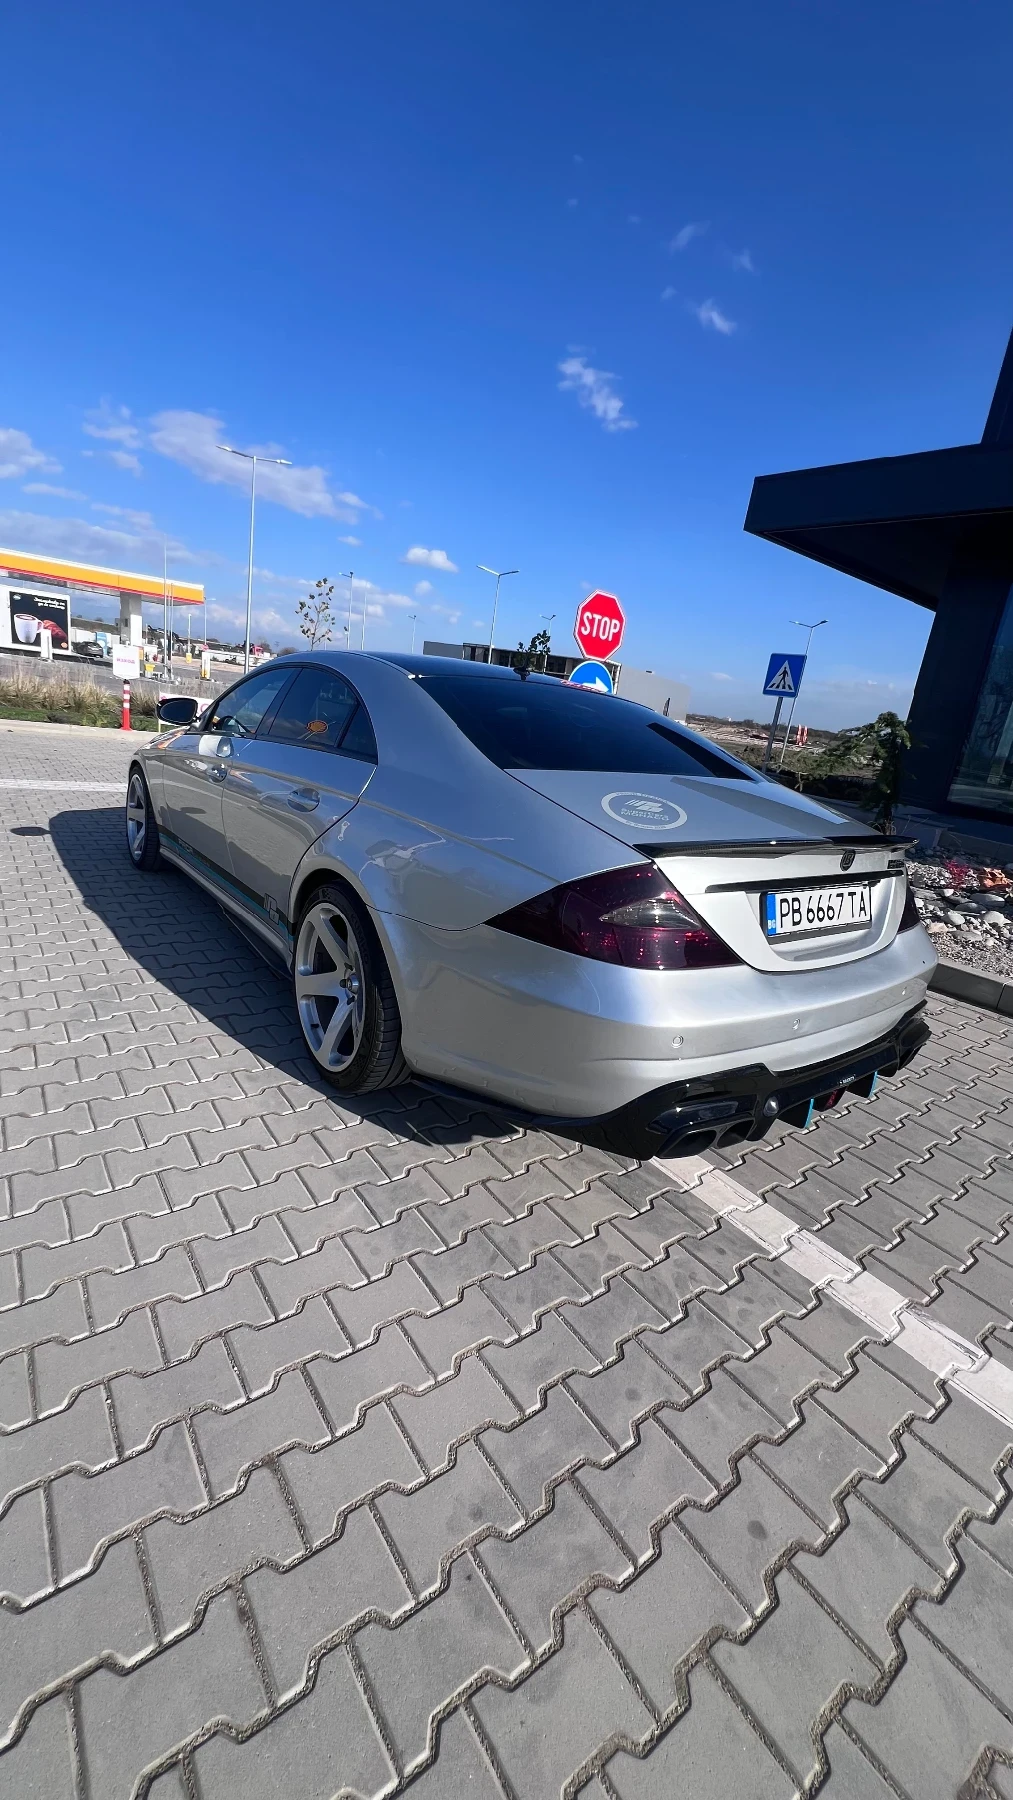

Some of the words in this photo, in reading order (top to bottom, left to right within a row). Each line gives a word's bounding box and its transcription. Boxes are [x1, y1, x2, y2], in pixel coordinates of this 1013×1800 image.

[581, 611, 620, 642] STOP
[807, 893, 844, 923] 6667
[767, 919, 776, 930] BG
